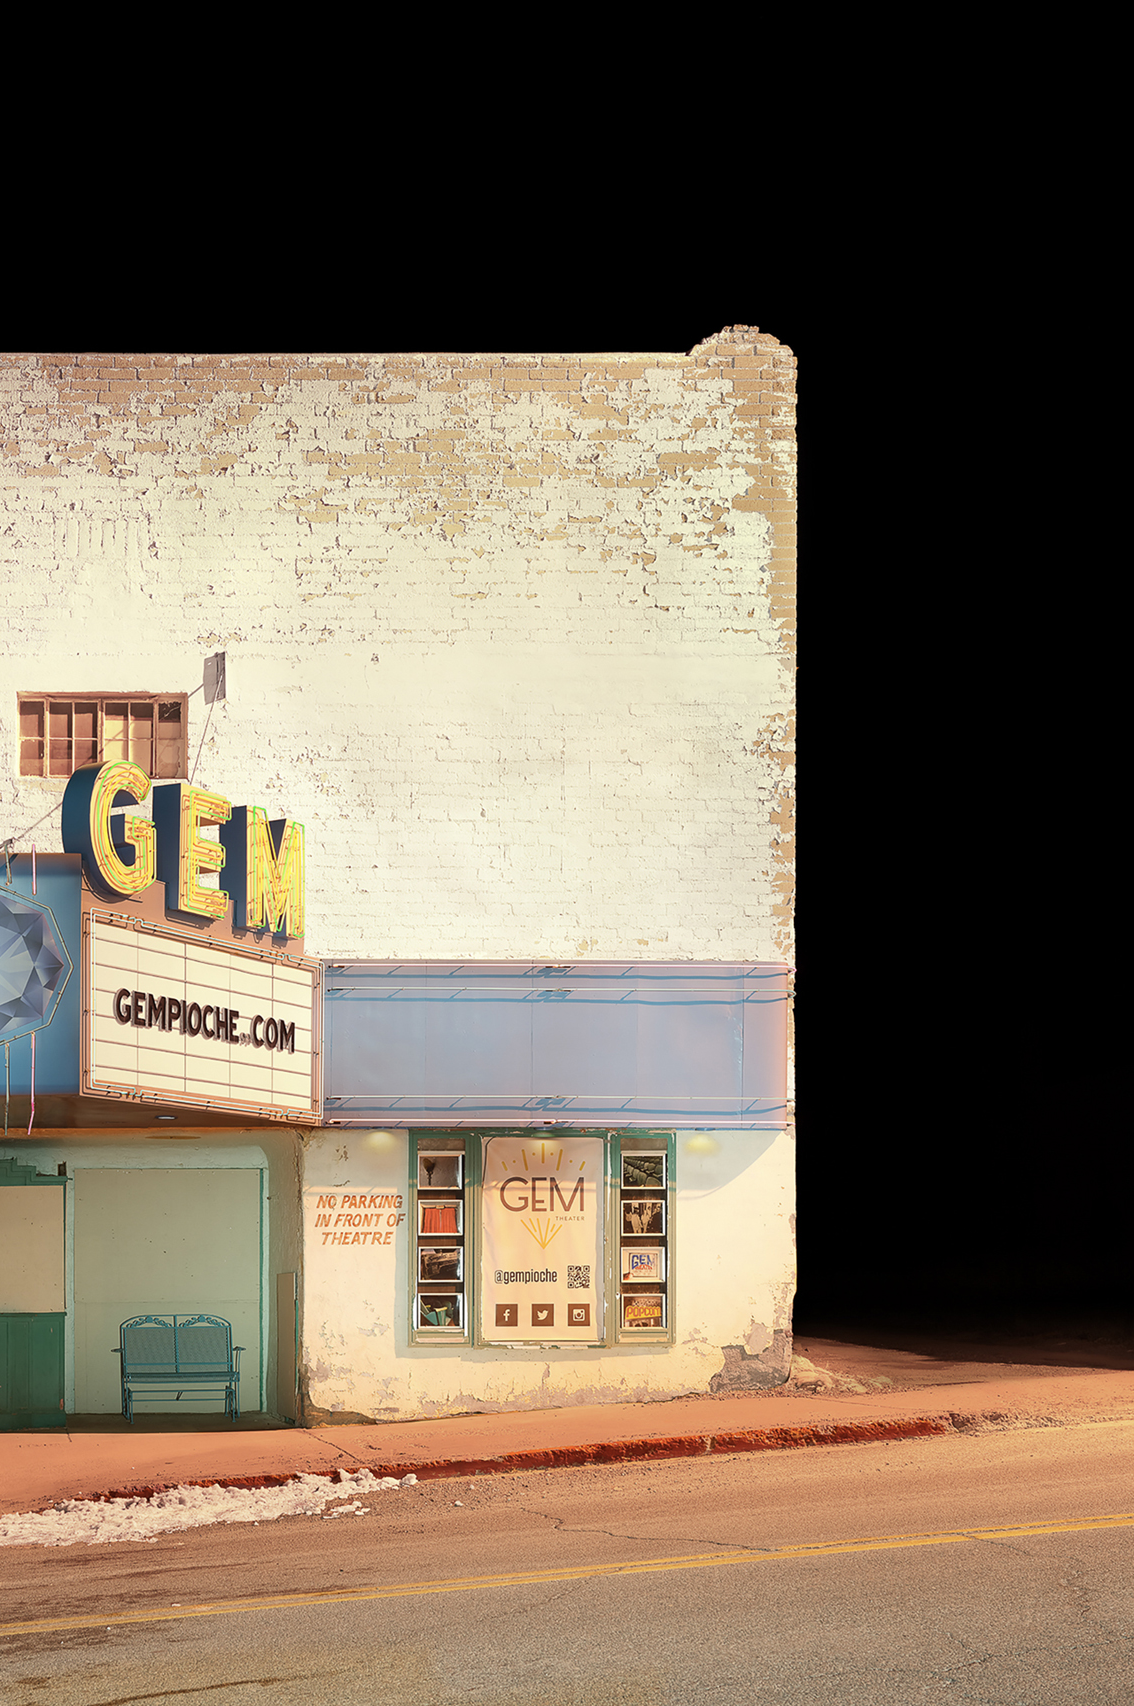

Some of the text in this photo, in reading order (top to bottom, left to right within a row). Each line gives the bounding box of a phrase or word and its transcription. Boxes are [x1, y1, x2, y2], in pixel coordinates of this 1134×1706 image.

[86, 759, 305, 940] GEM
[316, 1194, 403, 1210] NO PARKING
[499, 1176, 585, 1212] GEM
[314, 1213, 406, 1228] IN FRONT OF
[322, 1231, 394, 1246] THEATRE
[494, 1268, 558, 1285] @gempioche
